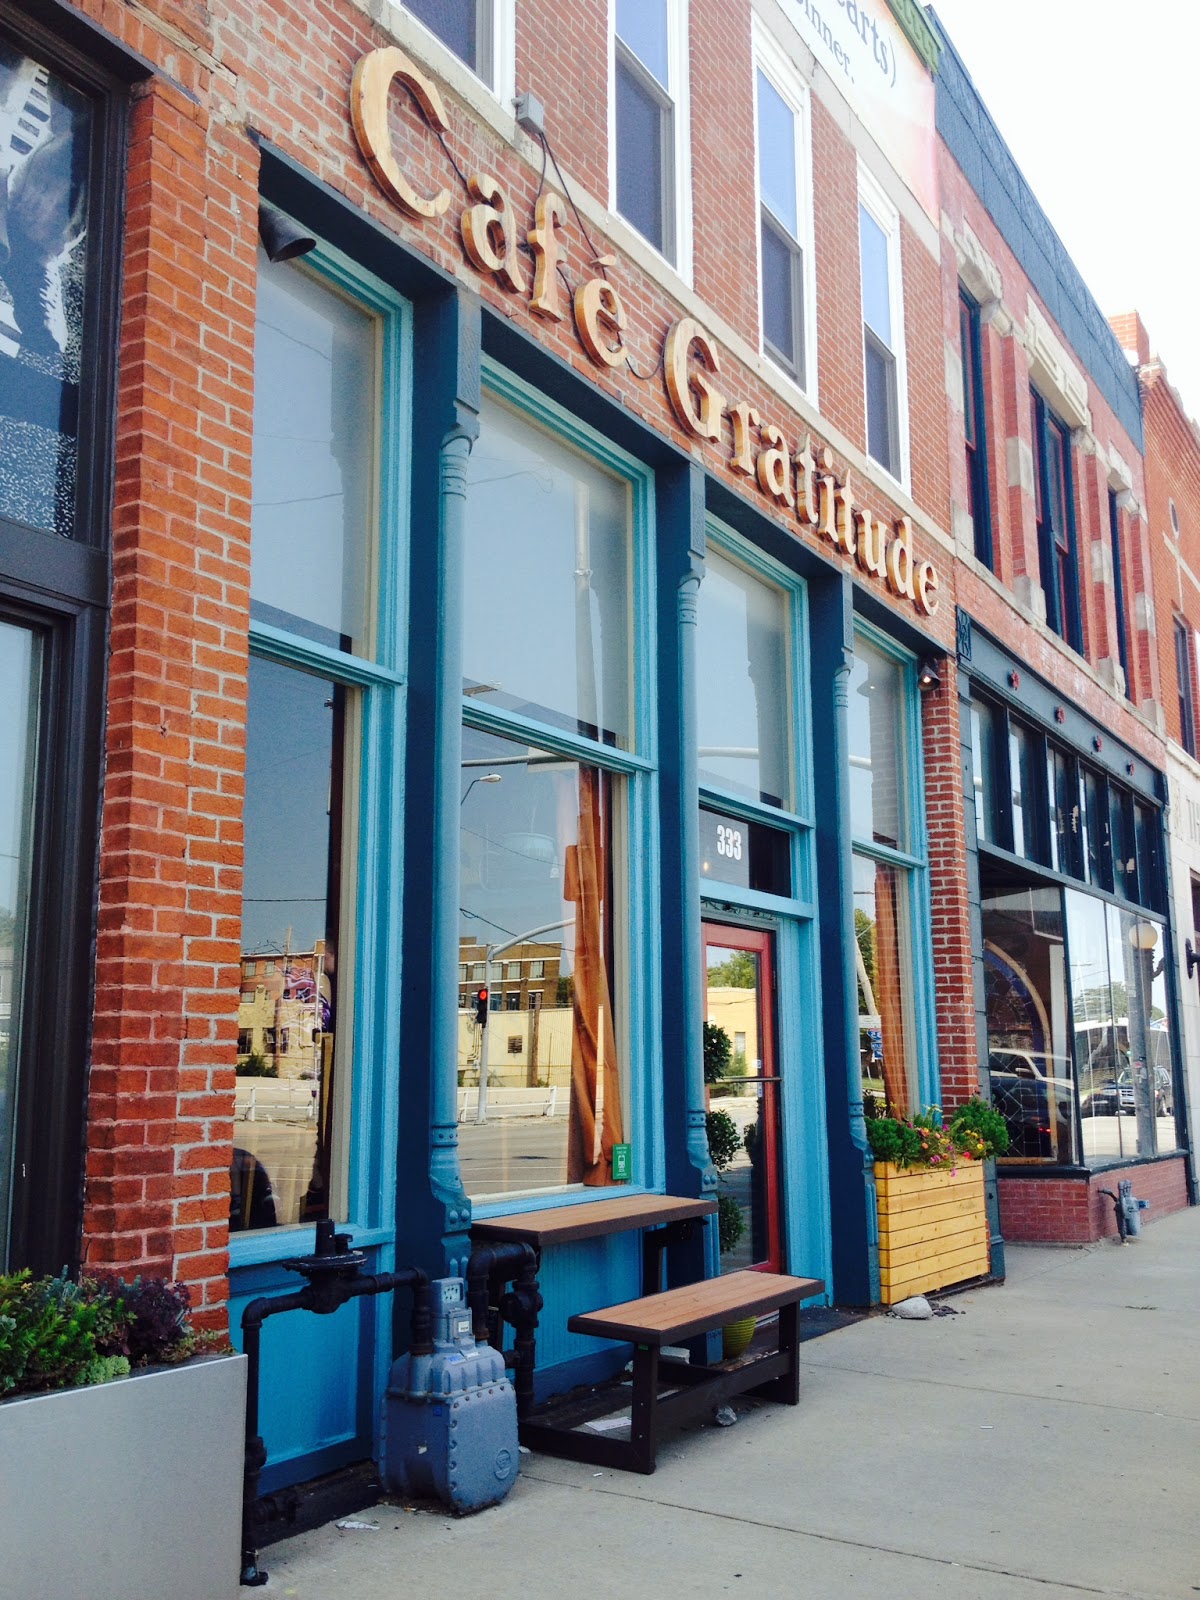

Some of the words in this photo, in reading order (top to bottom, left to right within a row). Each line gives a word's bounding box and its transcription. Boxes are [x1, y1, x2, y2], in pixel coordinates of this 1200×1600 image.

[796, 0, 855, 84] inner.
[837, 0, 896, 88] arts)
[351, 46, 628, 369] Café
[663, 317, 940, 617] Gratitude
[716, 824, 742, 861] 333
